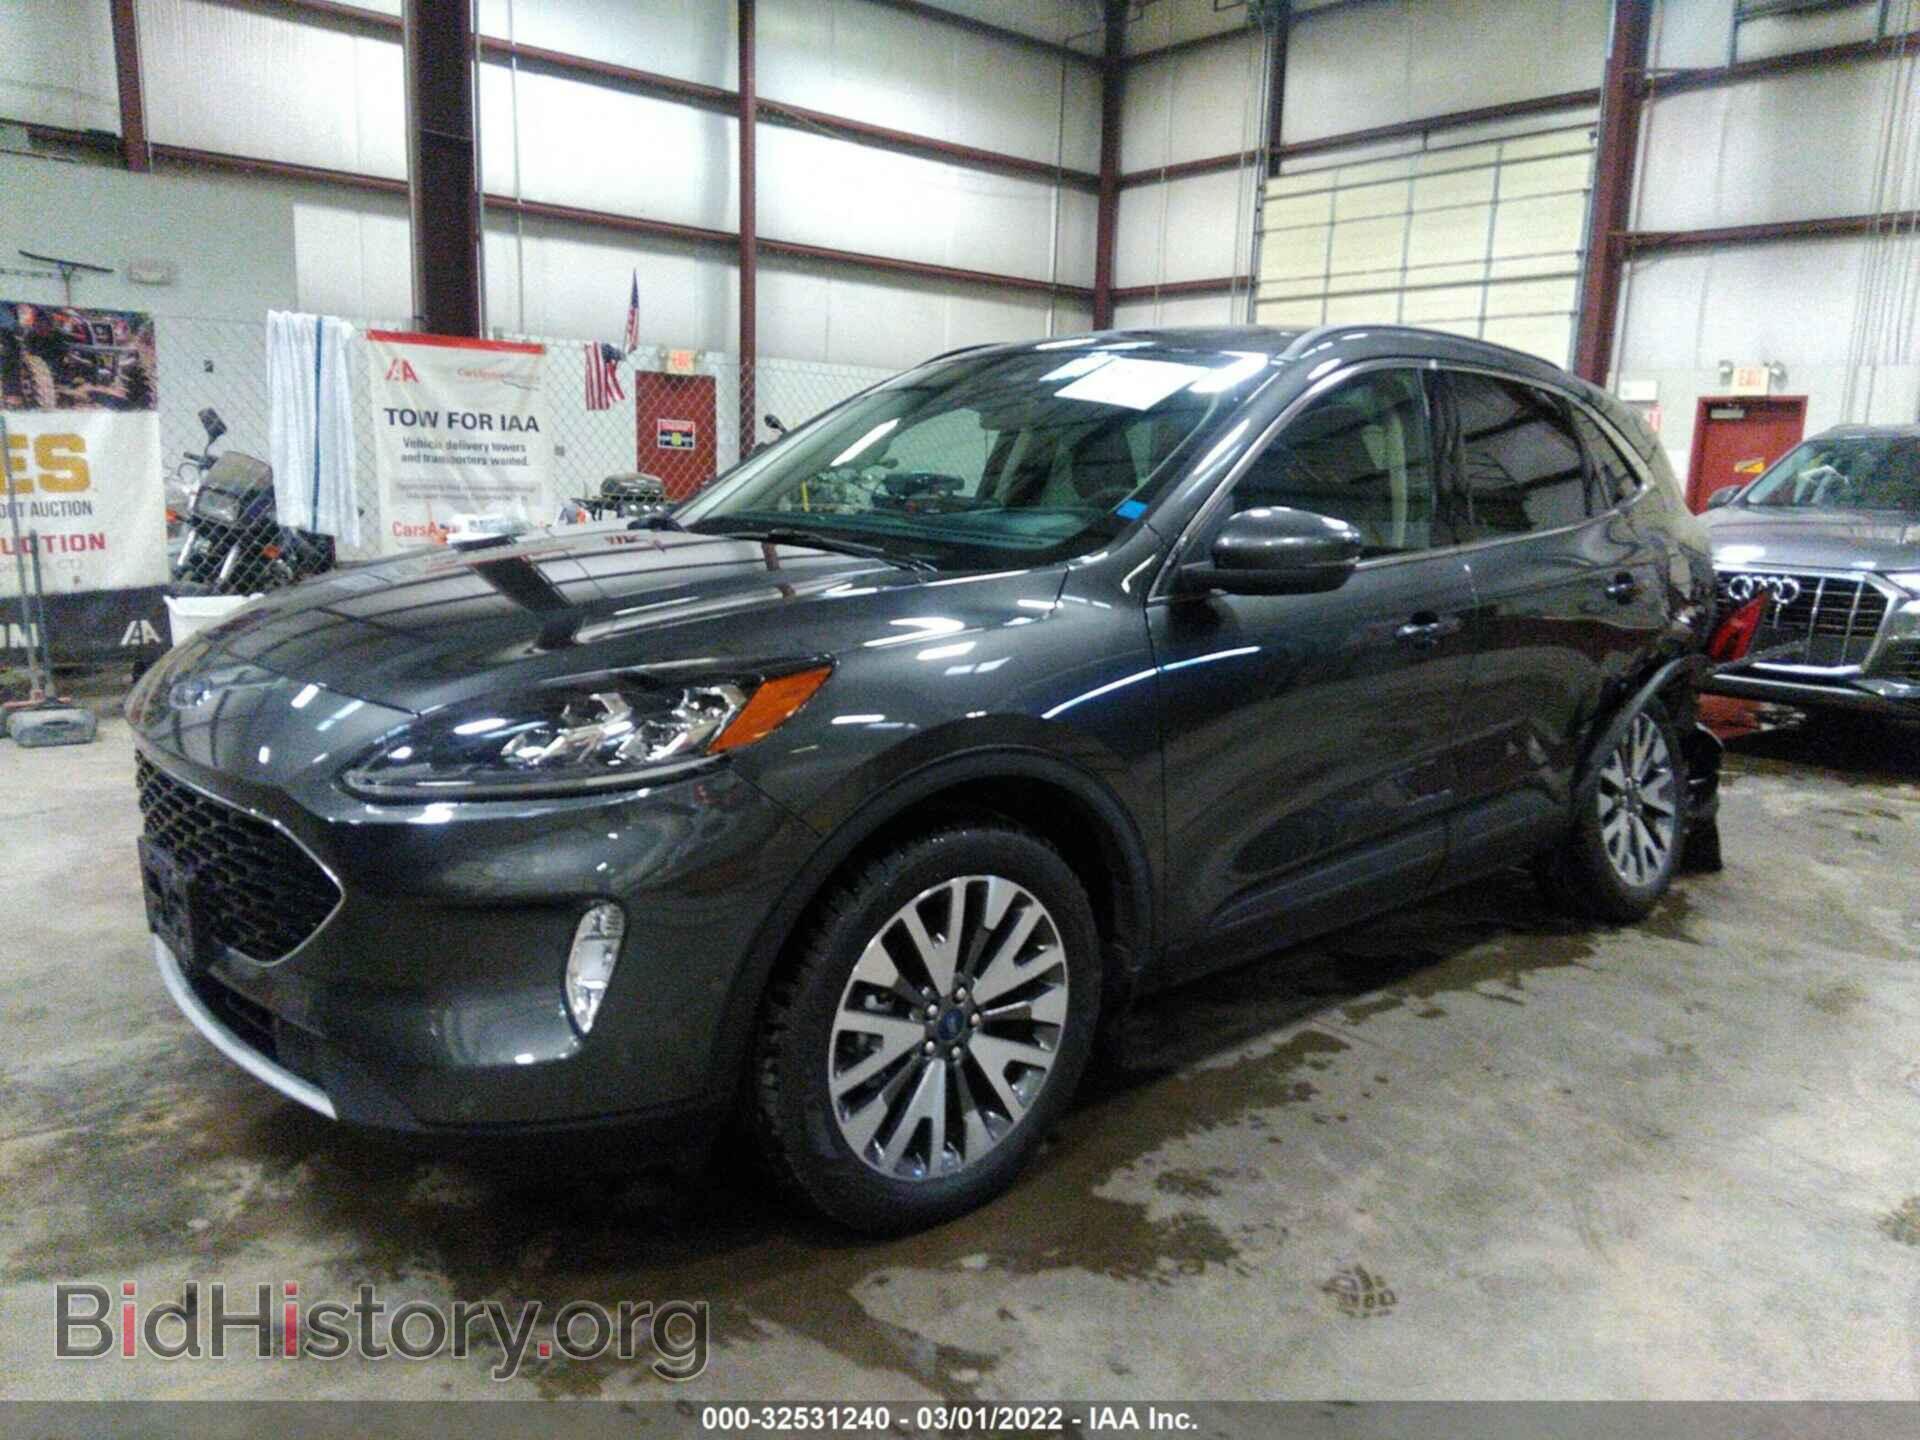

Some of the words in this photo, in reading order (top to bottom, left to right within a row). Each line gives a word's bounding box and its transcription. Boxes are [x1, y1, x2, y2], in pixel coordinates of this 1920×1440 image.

[384, 408, 438, 428] TOW
[448, 412, 493, 431] FOR
[500, 415, 540, 432] IAA
[446, 440, 489, 452] delivery
[492, 442, 526, 453] towers
[401, 454, 421, 464] and
[31, 500, 93, 517] AUCTION
